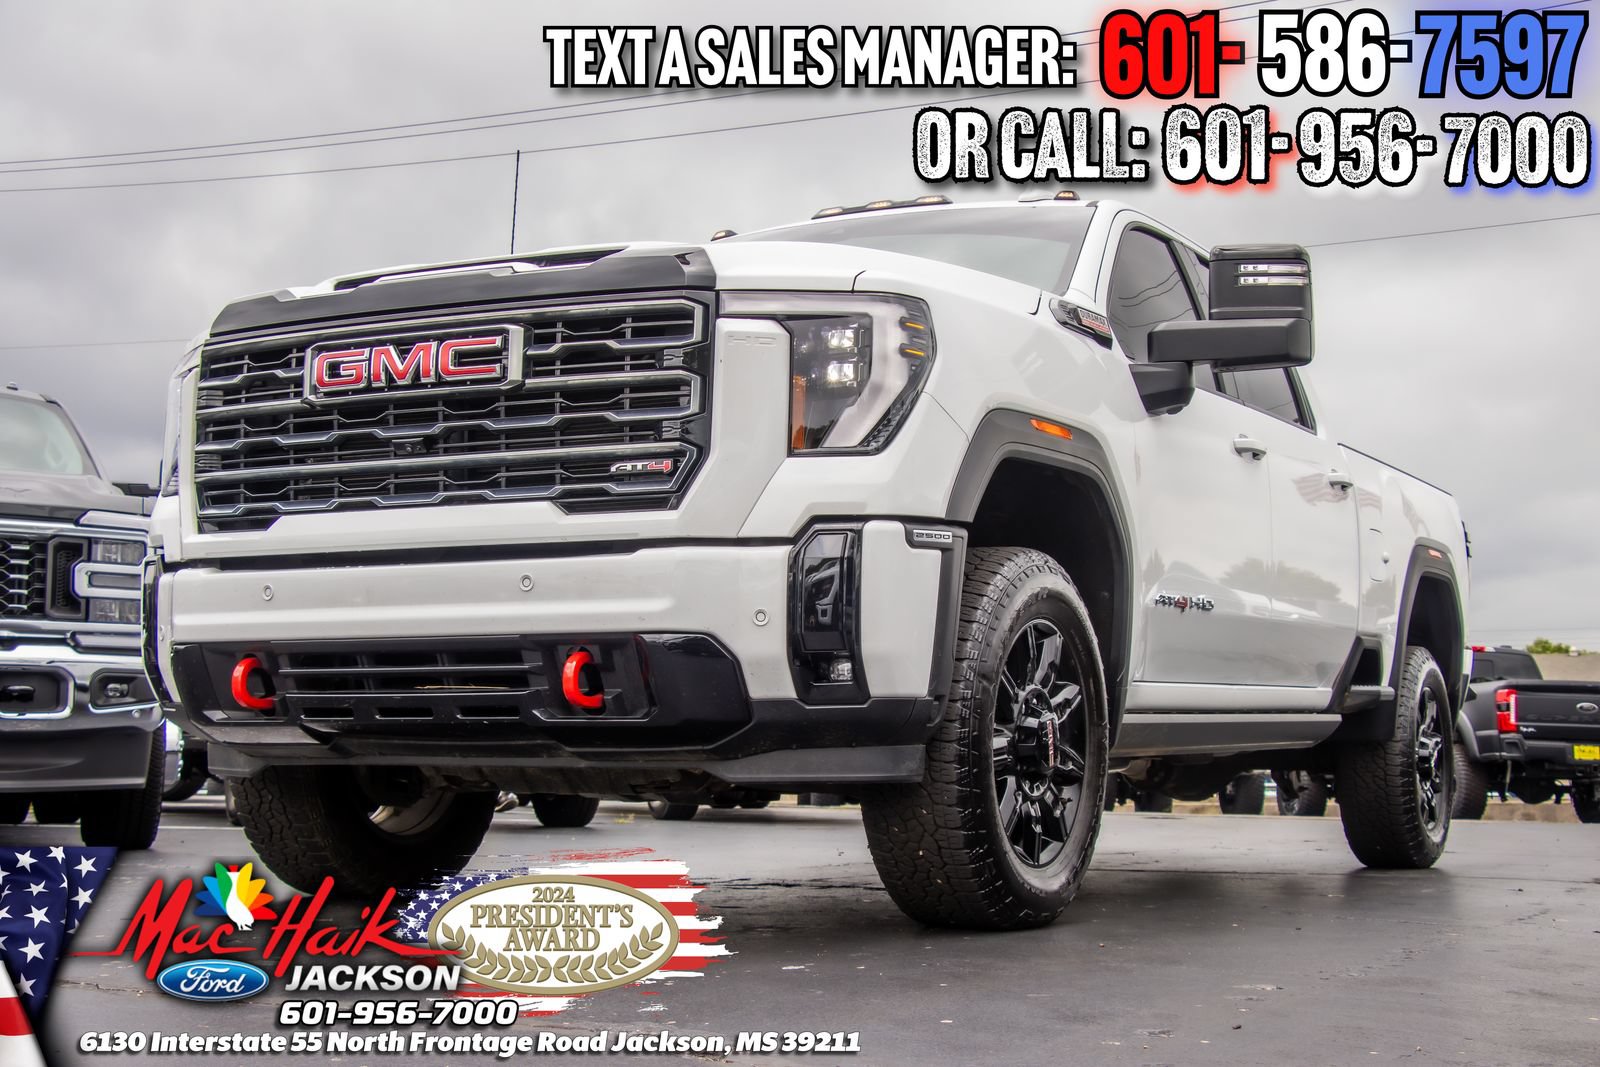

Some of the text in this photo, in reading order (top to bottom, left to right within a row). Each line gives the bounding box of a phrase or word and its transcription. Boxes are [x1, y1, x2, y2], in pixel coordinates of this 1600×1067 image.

[315, 335, 505, 391] GMC
[610, 458, 673, 474] AT4
[915, 532, 951, 540] 2500
